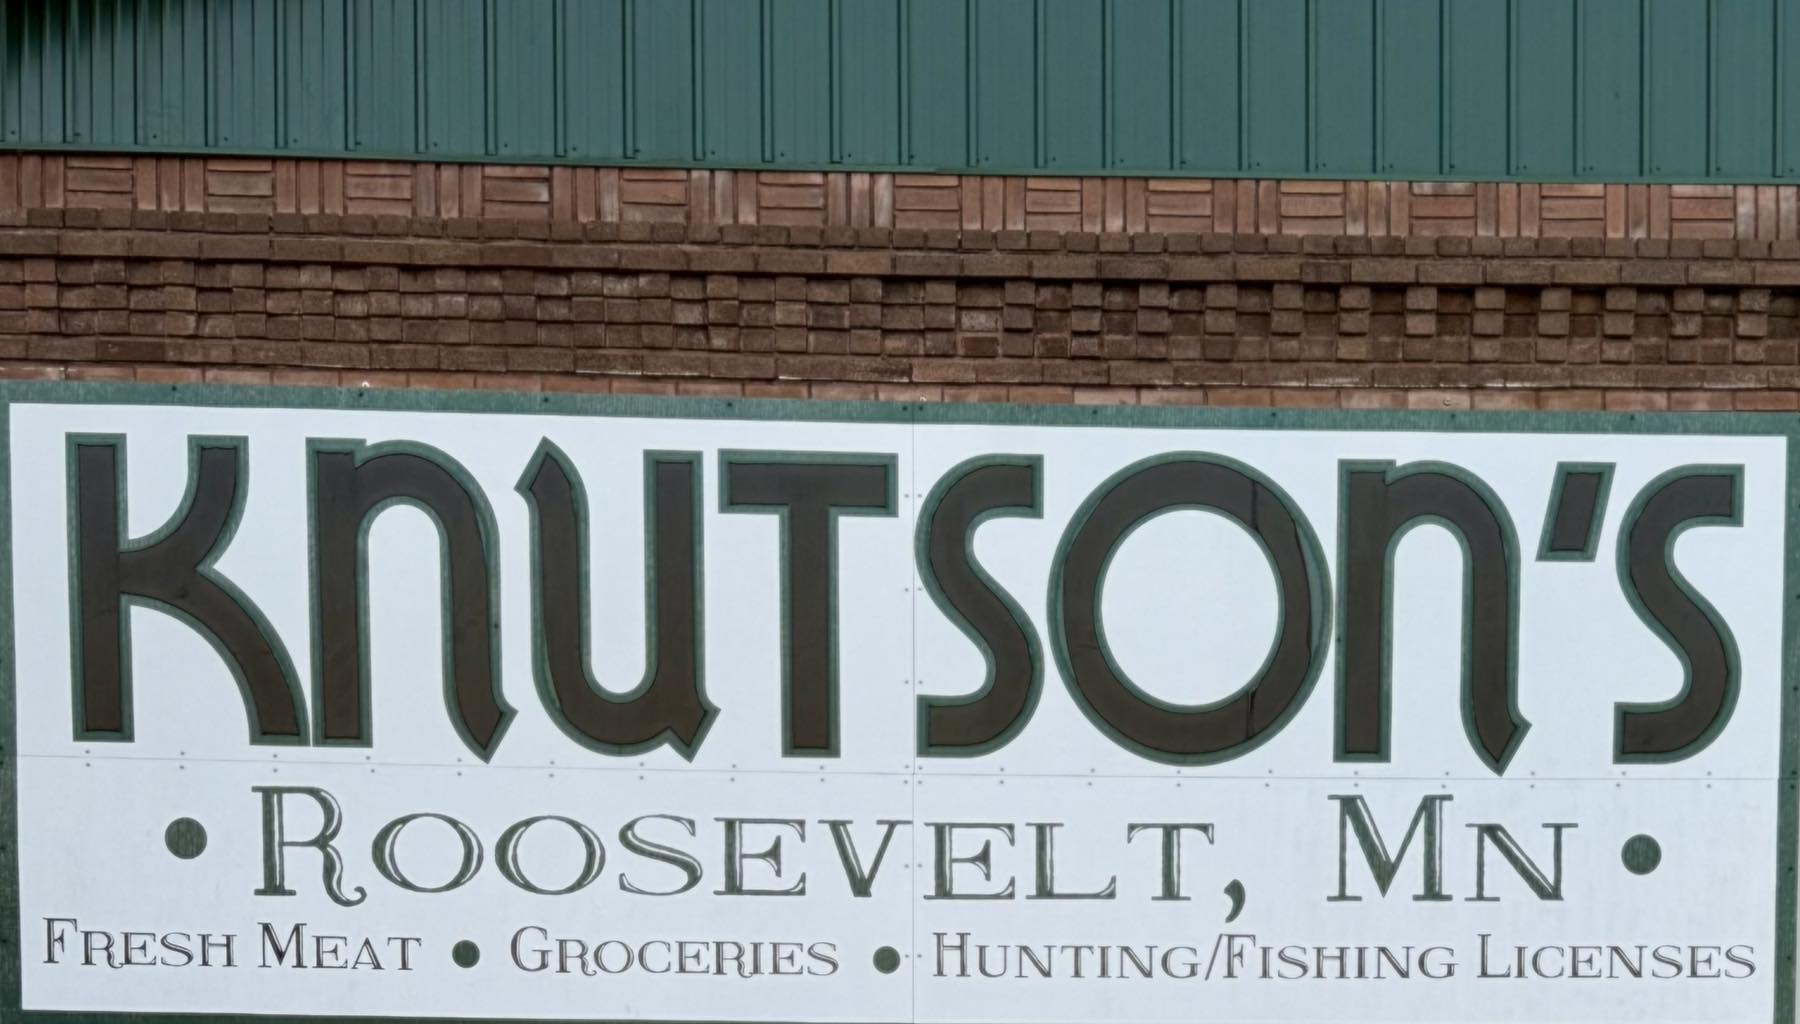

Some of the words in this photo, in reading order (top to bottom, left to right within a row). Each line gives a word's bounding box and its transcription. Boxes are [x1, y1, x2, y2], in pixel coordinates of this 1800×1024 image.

[251, 786, 1247, 923] ROOSEVELT,
[1326, 794, 1580, 902] MN
[42, 917, 237, 970] FRESH
[257, 922, 422, 971] MEAT
[510, 925, 840, 978] GROCERIES
[1477, 933, 1758, 980] LICENSES
